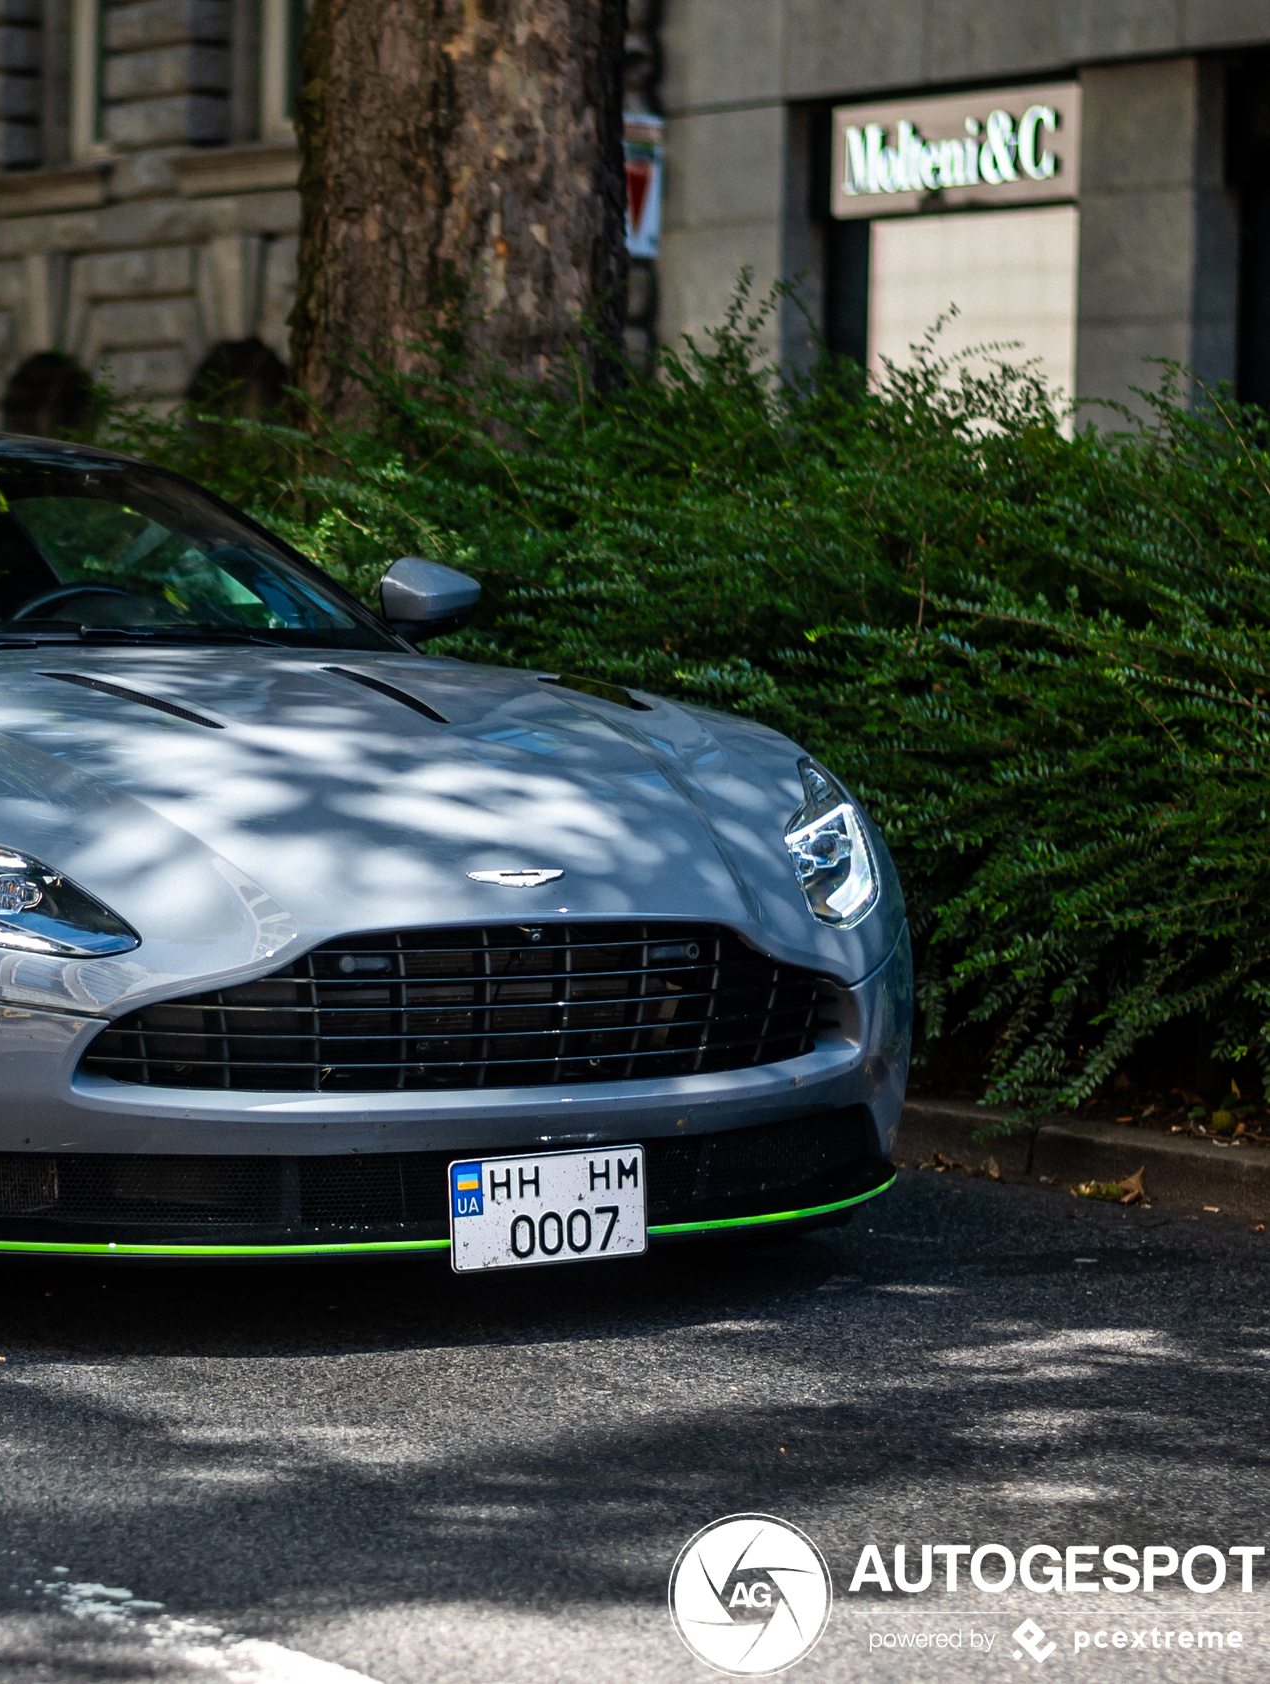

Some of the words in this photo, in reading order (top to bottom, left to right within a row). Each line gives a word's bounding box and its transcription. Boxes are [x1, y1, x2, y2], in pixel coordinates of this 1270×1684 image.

[842, 104, 1056, 196] Molteni&C
[489, 1165, 541, 1201] HH
[588, 1156, 638, 1191] HM
[457, 1196, 480, 1215] UA
[510, 1204, 620, 1258] 0007
